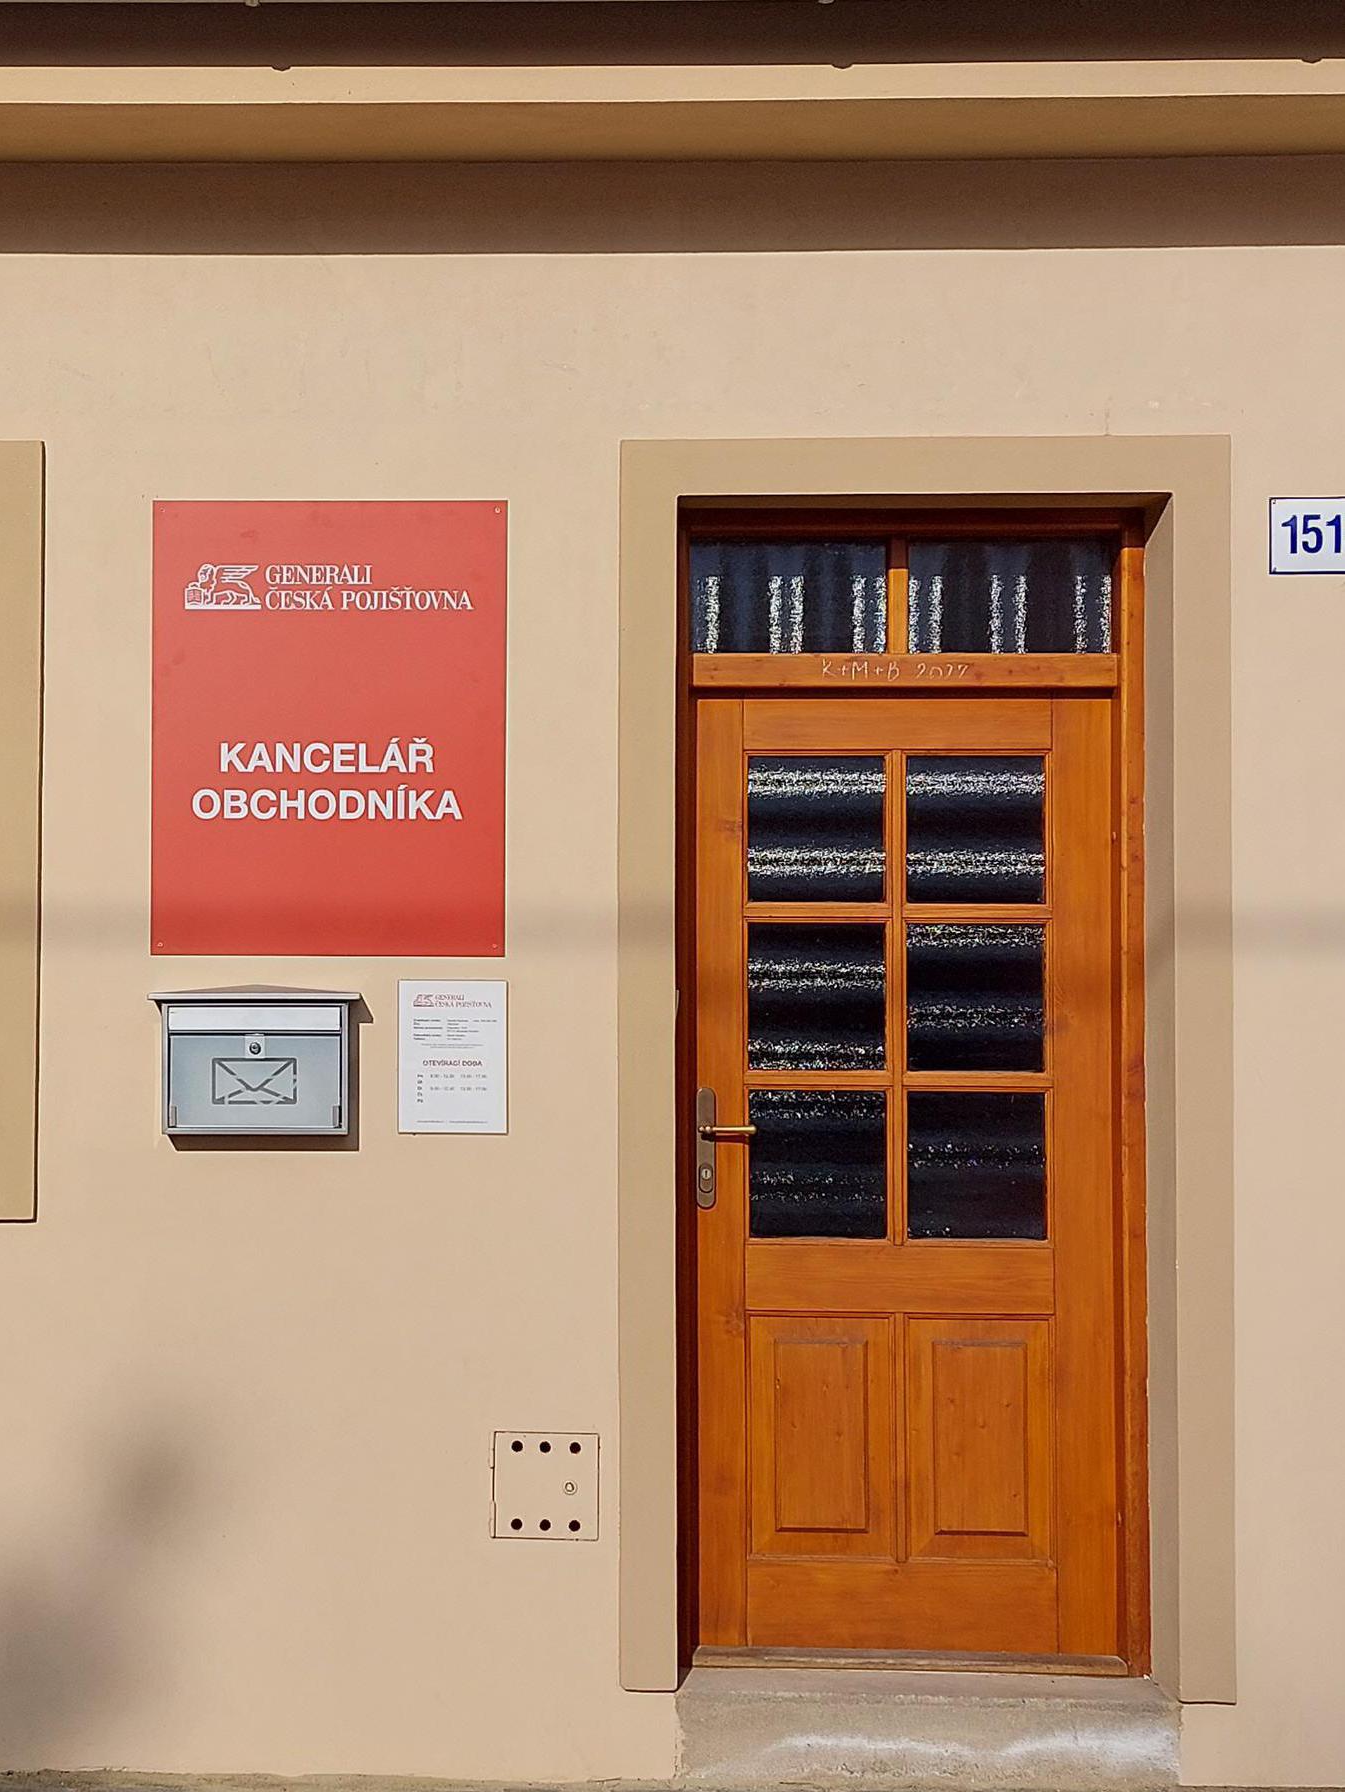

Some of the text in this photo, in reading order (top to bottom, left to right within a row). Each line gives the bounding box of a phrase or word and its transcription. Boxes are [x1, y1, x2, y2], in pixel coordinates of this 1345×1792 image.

[1281, 514, 1341, 554] 151
[265, 564, 373, 585] GENERALI
[264, 585, 474, 611] ČESKÁ POJIŠŤOVNA
[219, 736, 435, 774] KANCELÁŘ
[191, 784, 463, 820] OBCHODNÍKA
